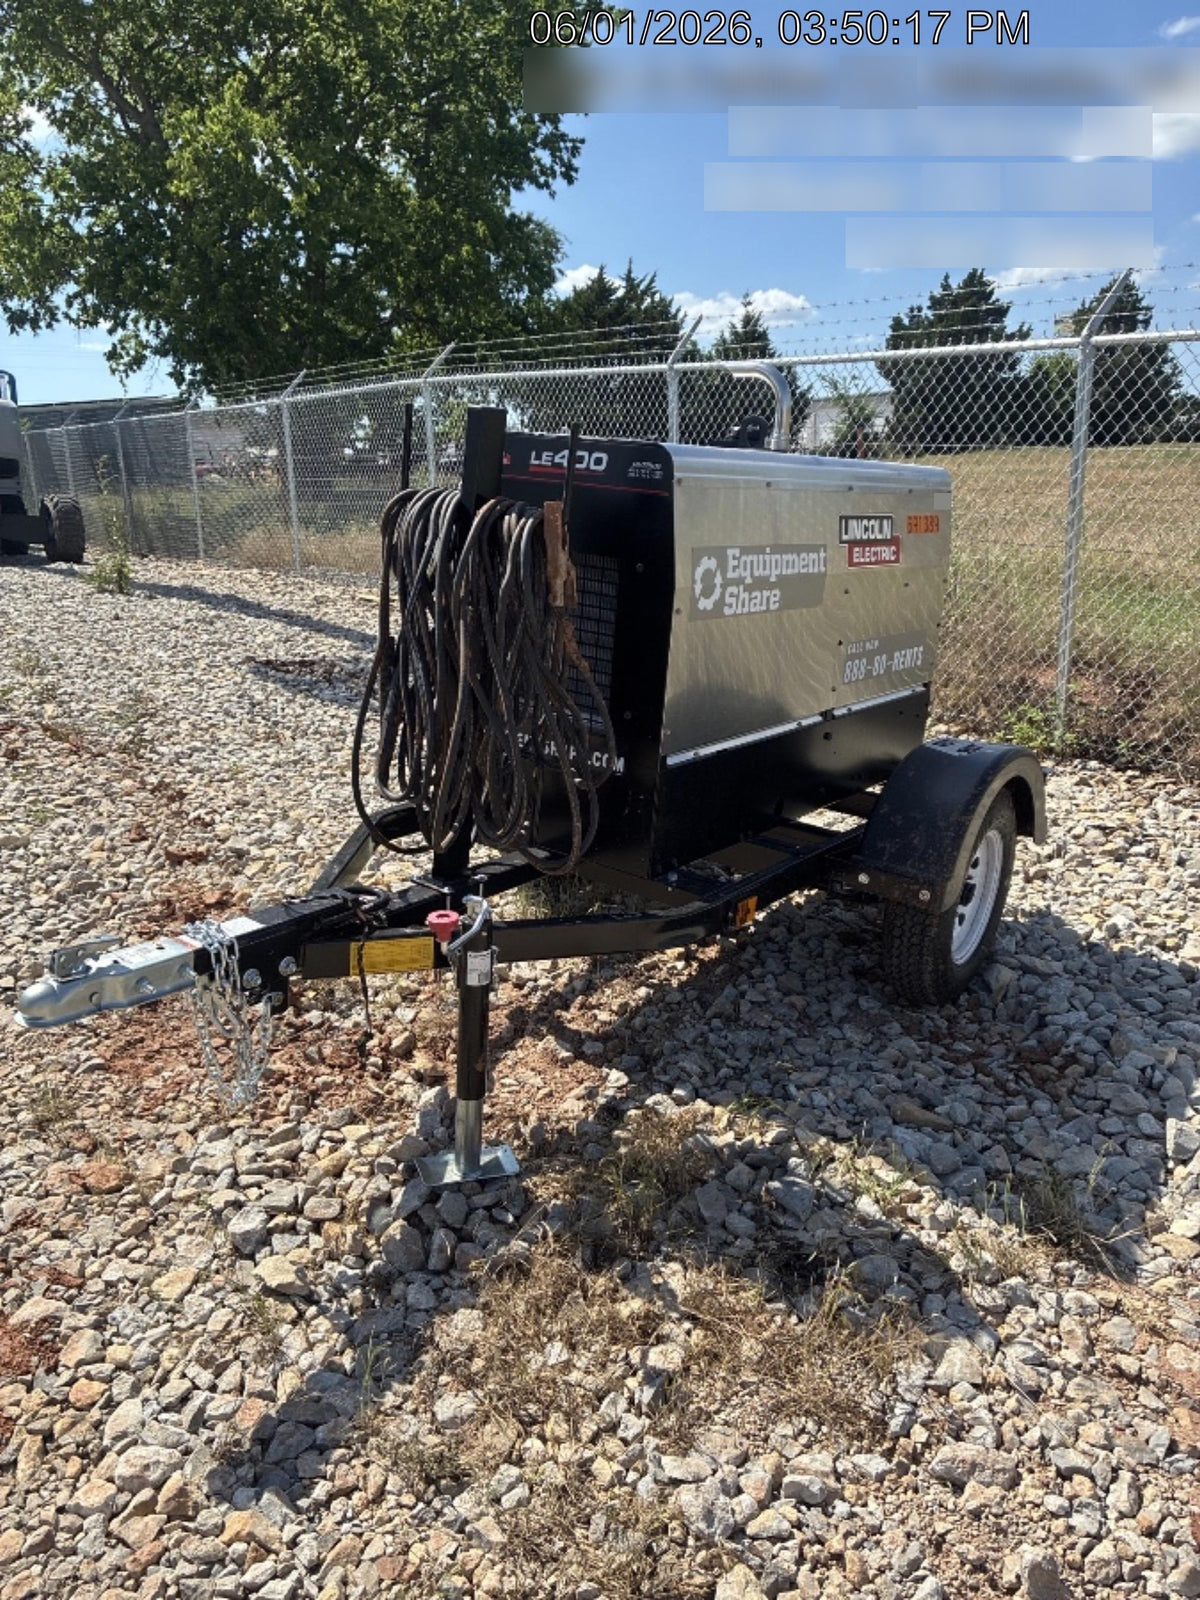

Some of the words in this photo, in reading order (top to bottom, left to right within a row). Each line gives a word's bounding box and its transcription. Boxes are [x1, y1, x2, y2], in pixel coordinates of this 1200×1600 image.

[529, 449, 609, 472] LE400
[841, 518, 892, 541] LINCOLN
[726, 547, 826, 584] Equipment
[853, 546, 897, 563] ELECTRIC
[723, 585, 781, 616] Share
[843, 645, 924, 683] 888-80-RENTS
